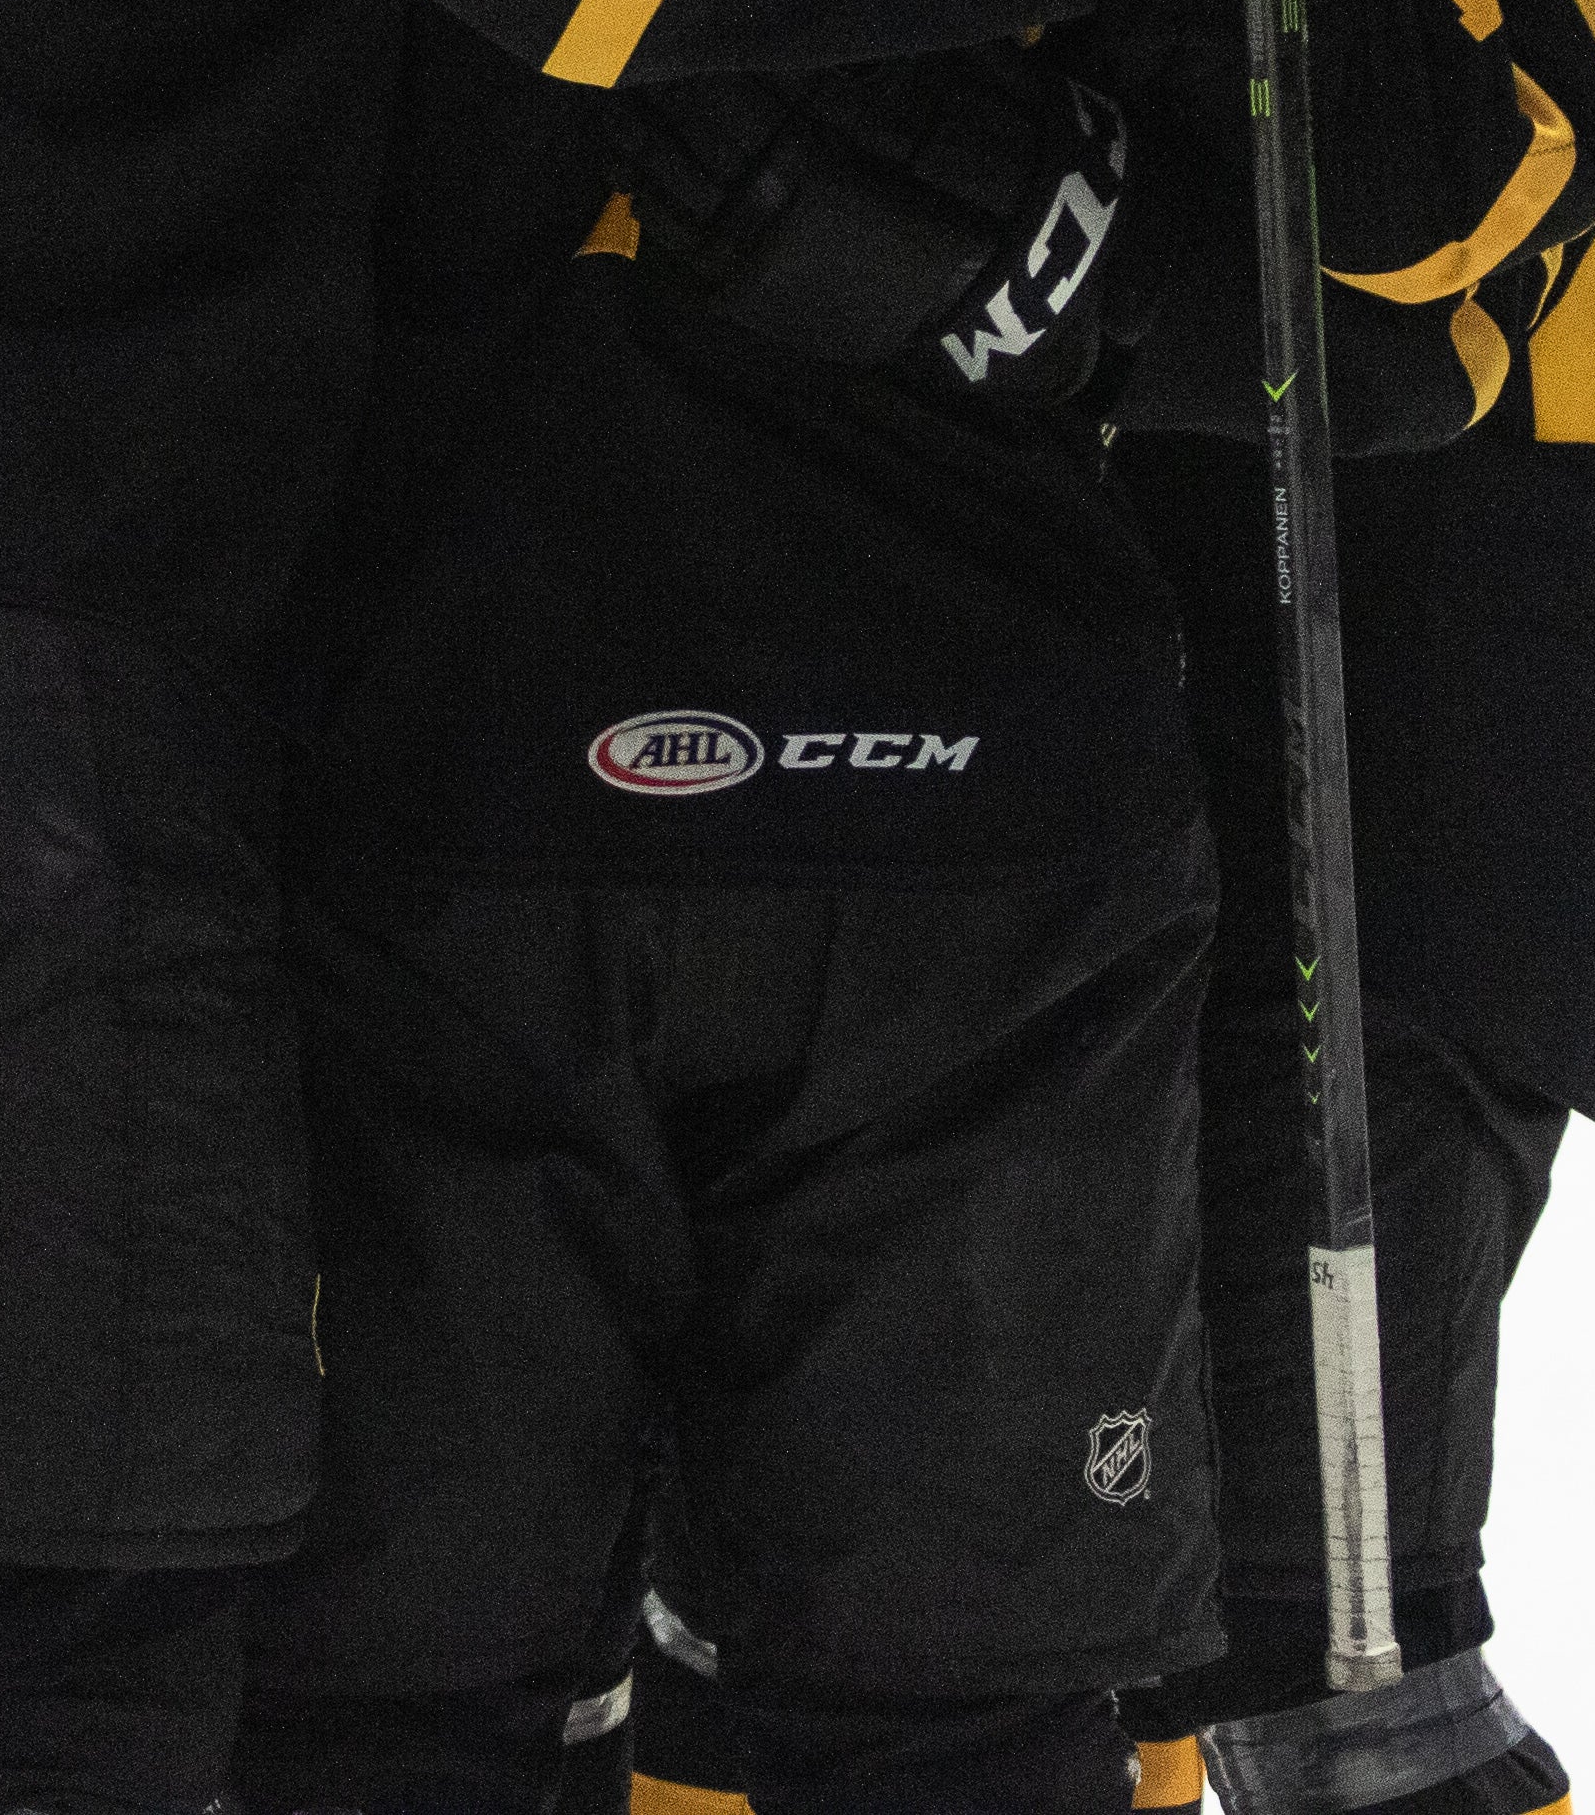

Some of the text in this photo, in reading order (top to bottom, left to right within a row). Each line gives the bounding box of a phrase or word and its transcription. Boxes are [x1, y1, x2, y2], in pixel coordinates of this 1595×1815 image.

[939, 78, 1128, 384] CCM
[1273, 487, 1293, 605] KOPPANEN
[631, 731, 982, 773] AHL CCM
[1102, 1431, 1141, 1487] NHL
